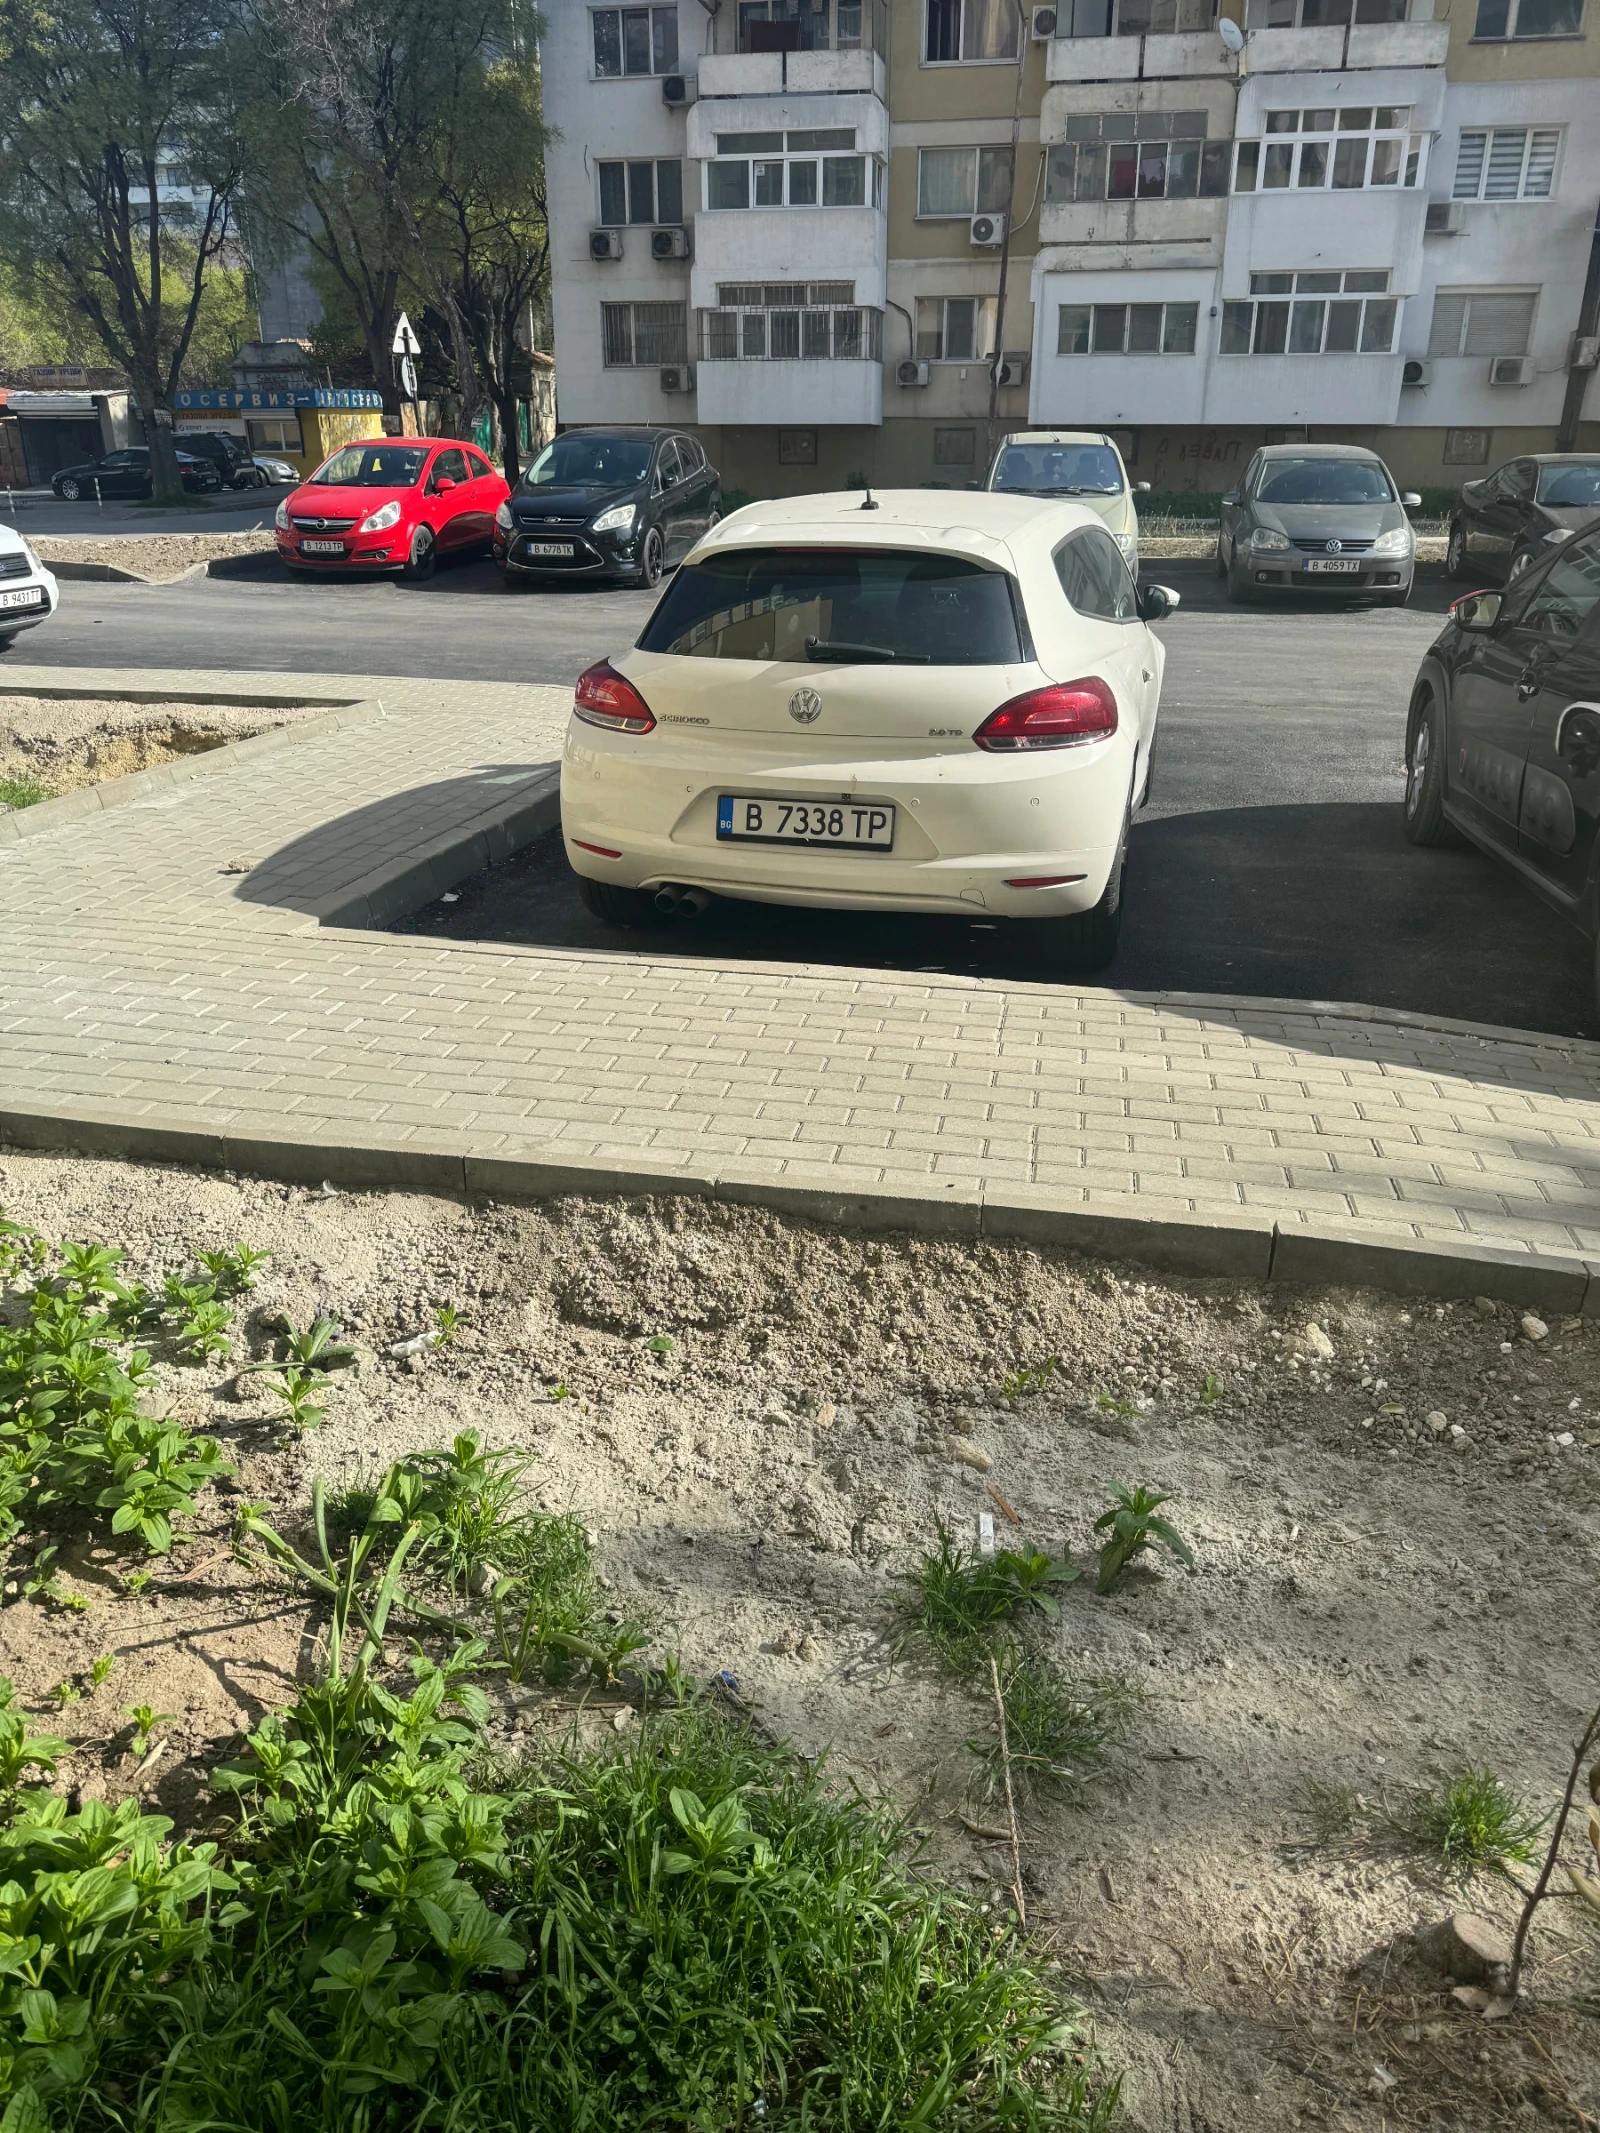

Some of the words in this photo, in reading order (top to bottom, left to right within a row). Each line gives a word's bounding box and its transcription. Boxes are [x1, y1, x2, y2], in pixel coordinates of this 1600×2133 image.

[659, 713, 710, 725] SCIROCCO
[720, 819, 731, 829] BG
[745, 803, 763, 832] B
[776, 804, 844, 837] 7338
[851, 809, 887, 839] TP
